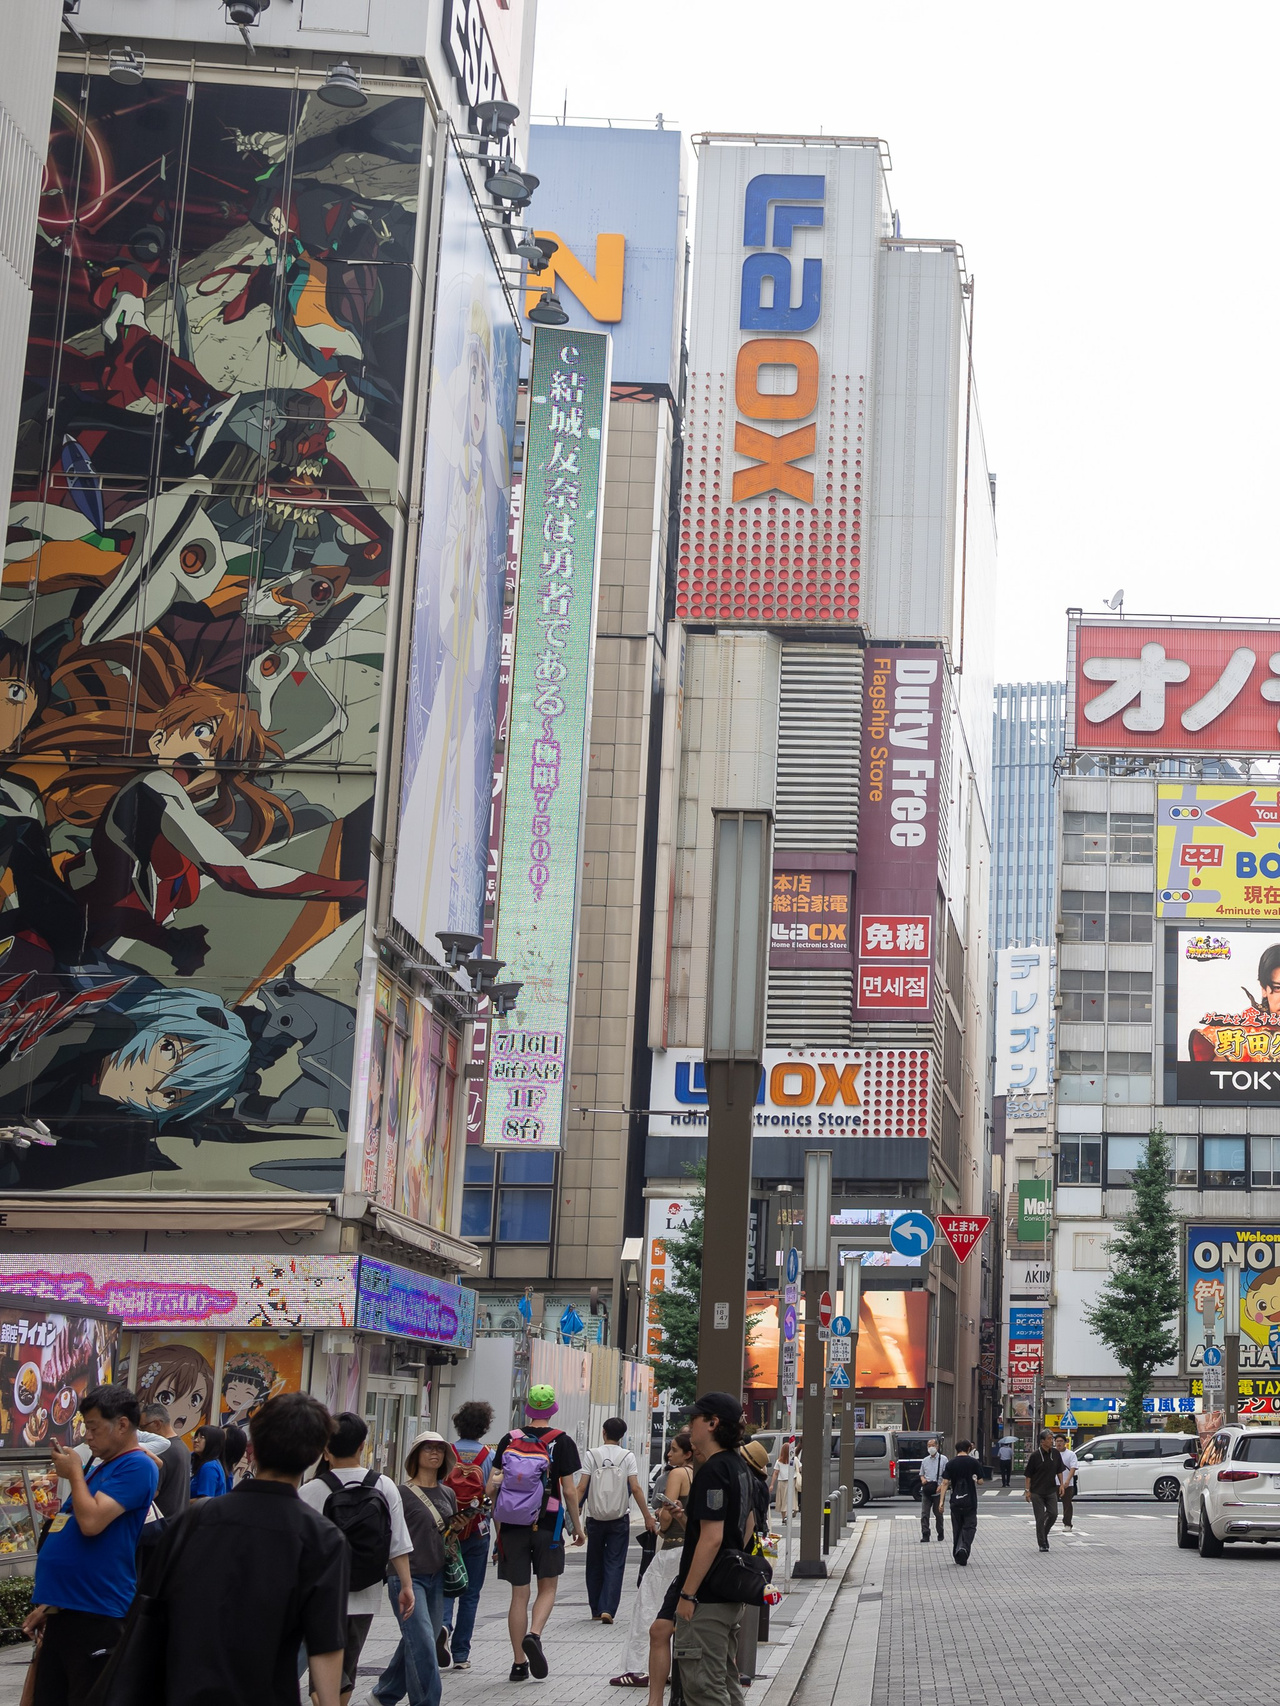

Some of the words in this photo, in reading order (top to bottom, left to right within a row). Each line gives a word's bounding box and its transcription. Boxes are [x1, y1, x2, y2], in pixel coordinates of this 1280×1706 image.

[869, 657, 892, 740] Flagship
[888, 658, 939, 750] Duty
[868, 745, 889, 803] Store
[890, 759, 936, 848] Free
[1255, 809, 1278, 820] You
[773, 874, 812, 894] 本店
[772, 894, 848, 915] 総合家電
[771, 941, 793, 949] Home
[794, 941, 830, 949] Electronics
[830, 941, 848, 949] Store
[865, 920, 926, 954] 免税
[862, 975, 926, 998] 면세점
[1009, 954, 1040, 1088] テレオン
[819, 1111, 862, 1127] Store
[947, 1221, 979, 1233] 止まれ
[952, 1233, 975, 1244] STOP
